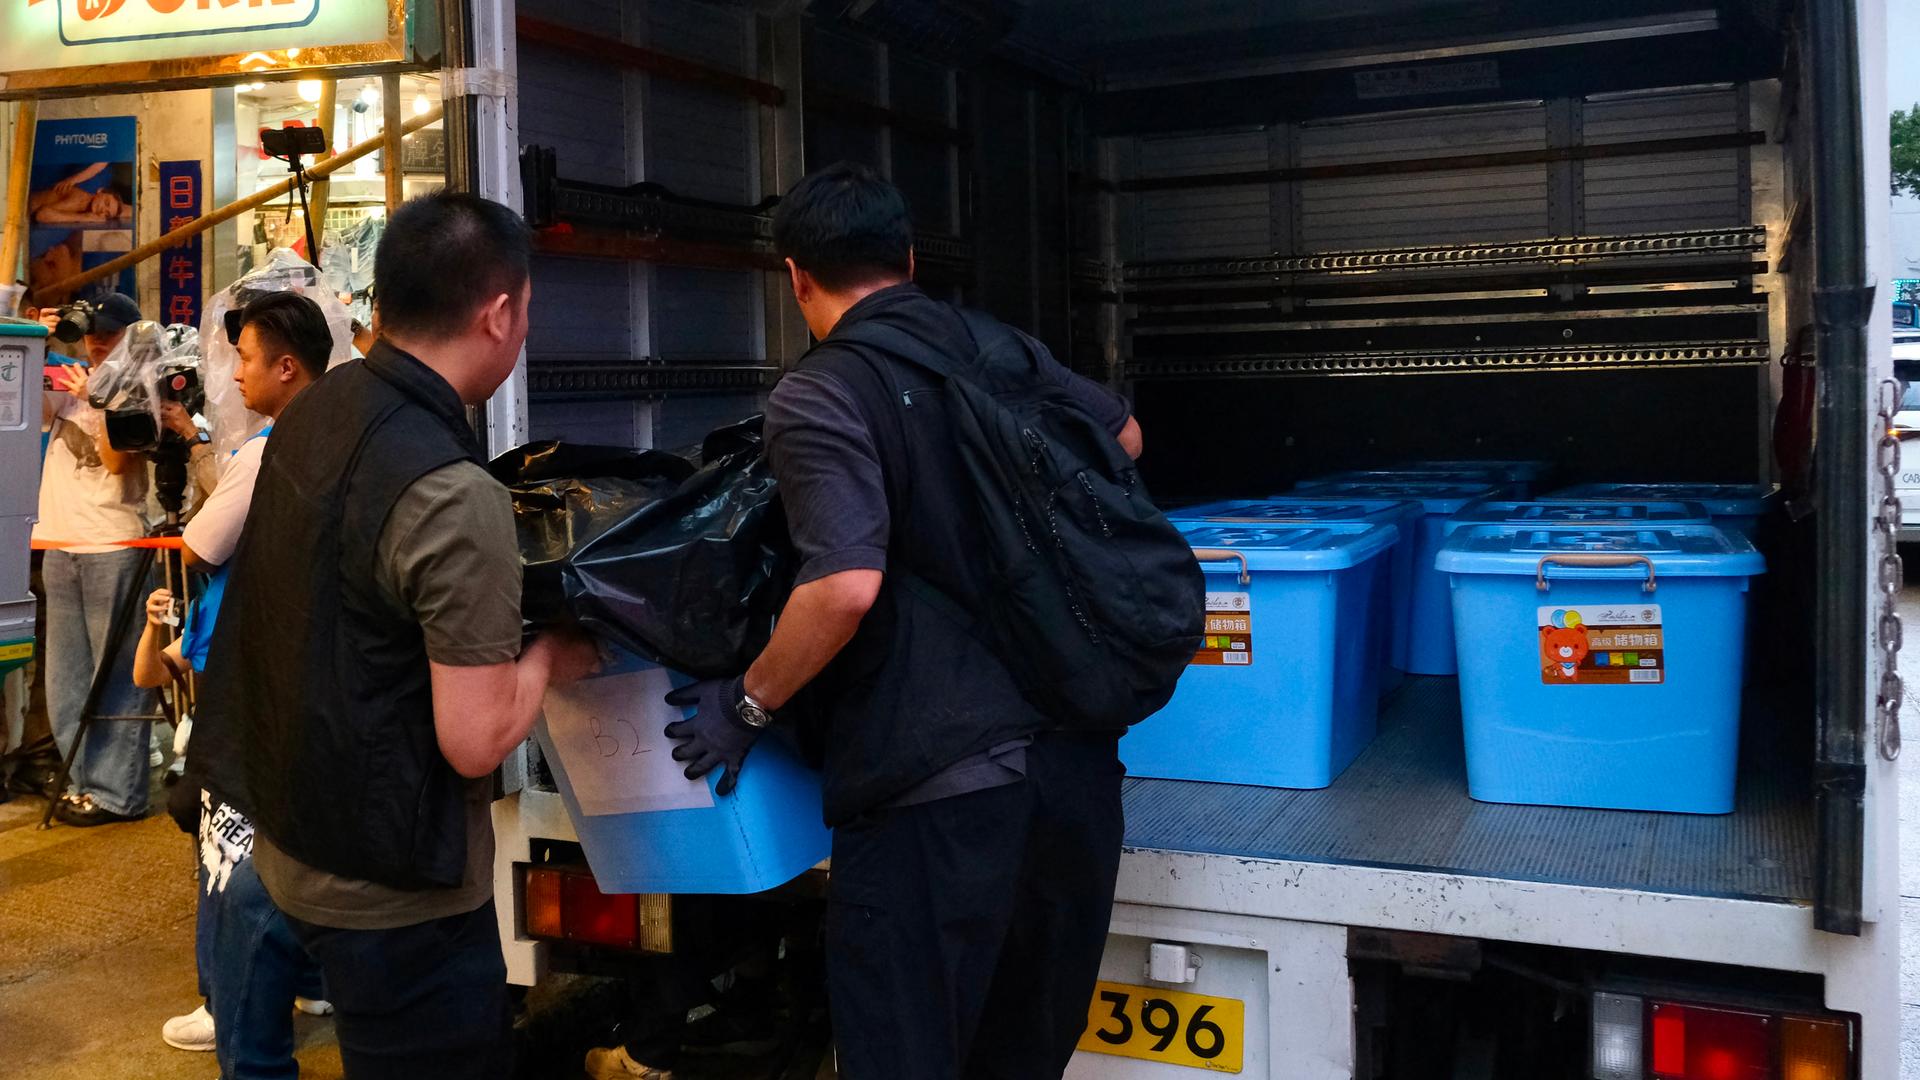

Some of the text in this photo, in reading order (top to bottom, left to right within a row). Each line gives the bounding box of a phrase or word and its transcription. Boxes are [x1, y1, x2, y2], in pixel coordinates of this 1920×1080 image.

[55, 133, 108, 145] PHYTOMER
[1206, 619, 1247, 631] 储物箱
[589, 716, 652, 758] B2
[212, 809, 253, 854] GREA
[1095, 990, 1225, 1059] 396
